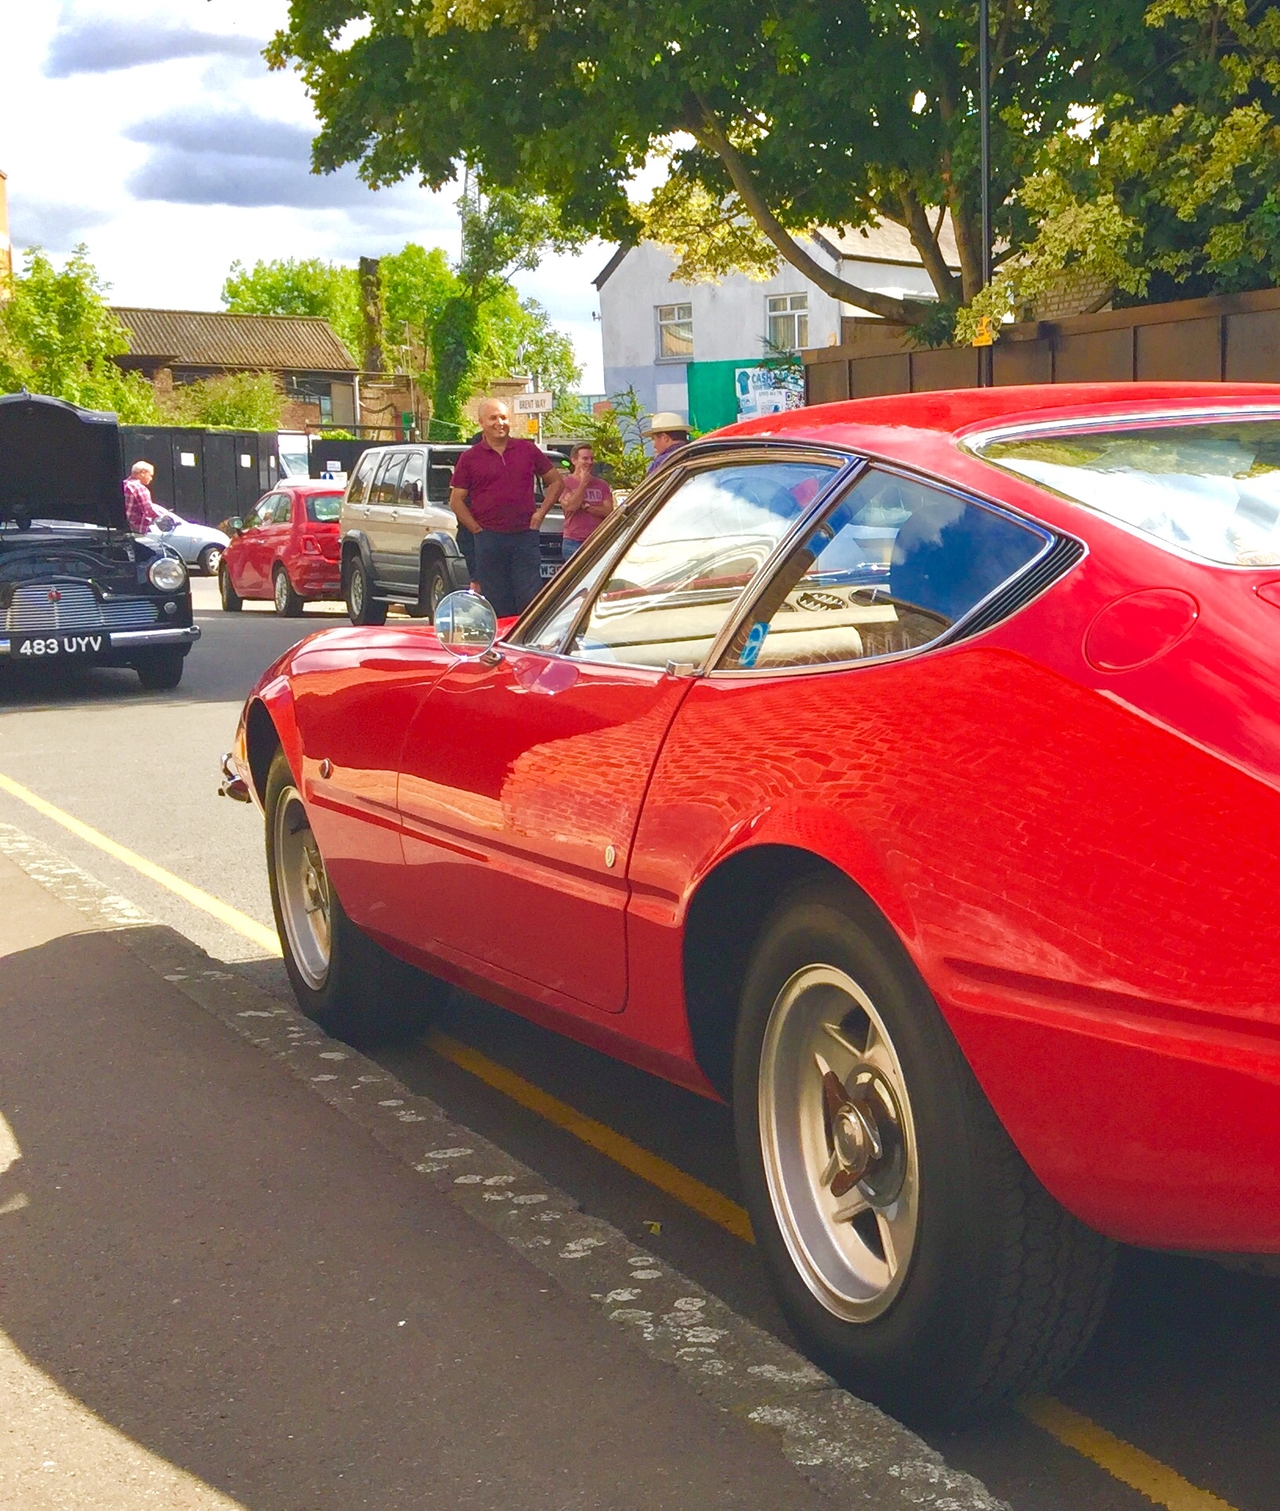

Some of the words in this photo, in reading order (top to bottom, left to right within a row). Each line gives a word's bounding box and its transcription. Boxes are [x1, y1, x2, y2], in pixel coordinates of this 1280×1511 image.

[751, 373, 772, 384] CASH
[519, 399, 533, 409] BRENT
[535, 399, 546, 408] WAY
[19, 639, 59, 655] 483
[63, 636, 102, 653] UYV
